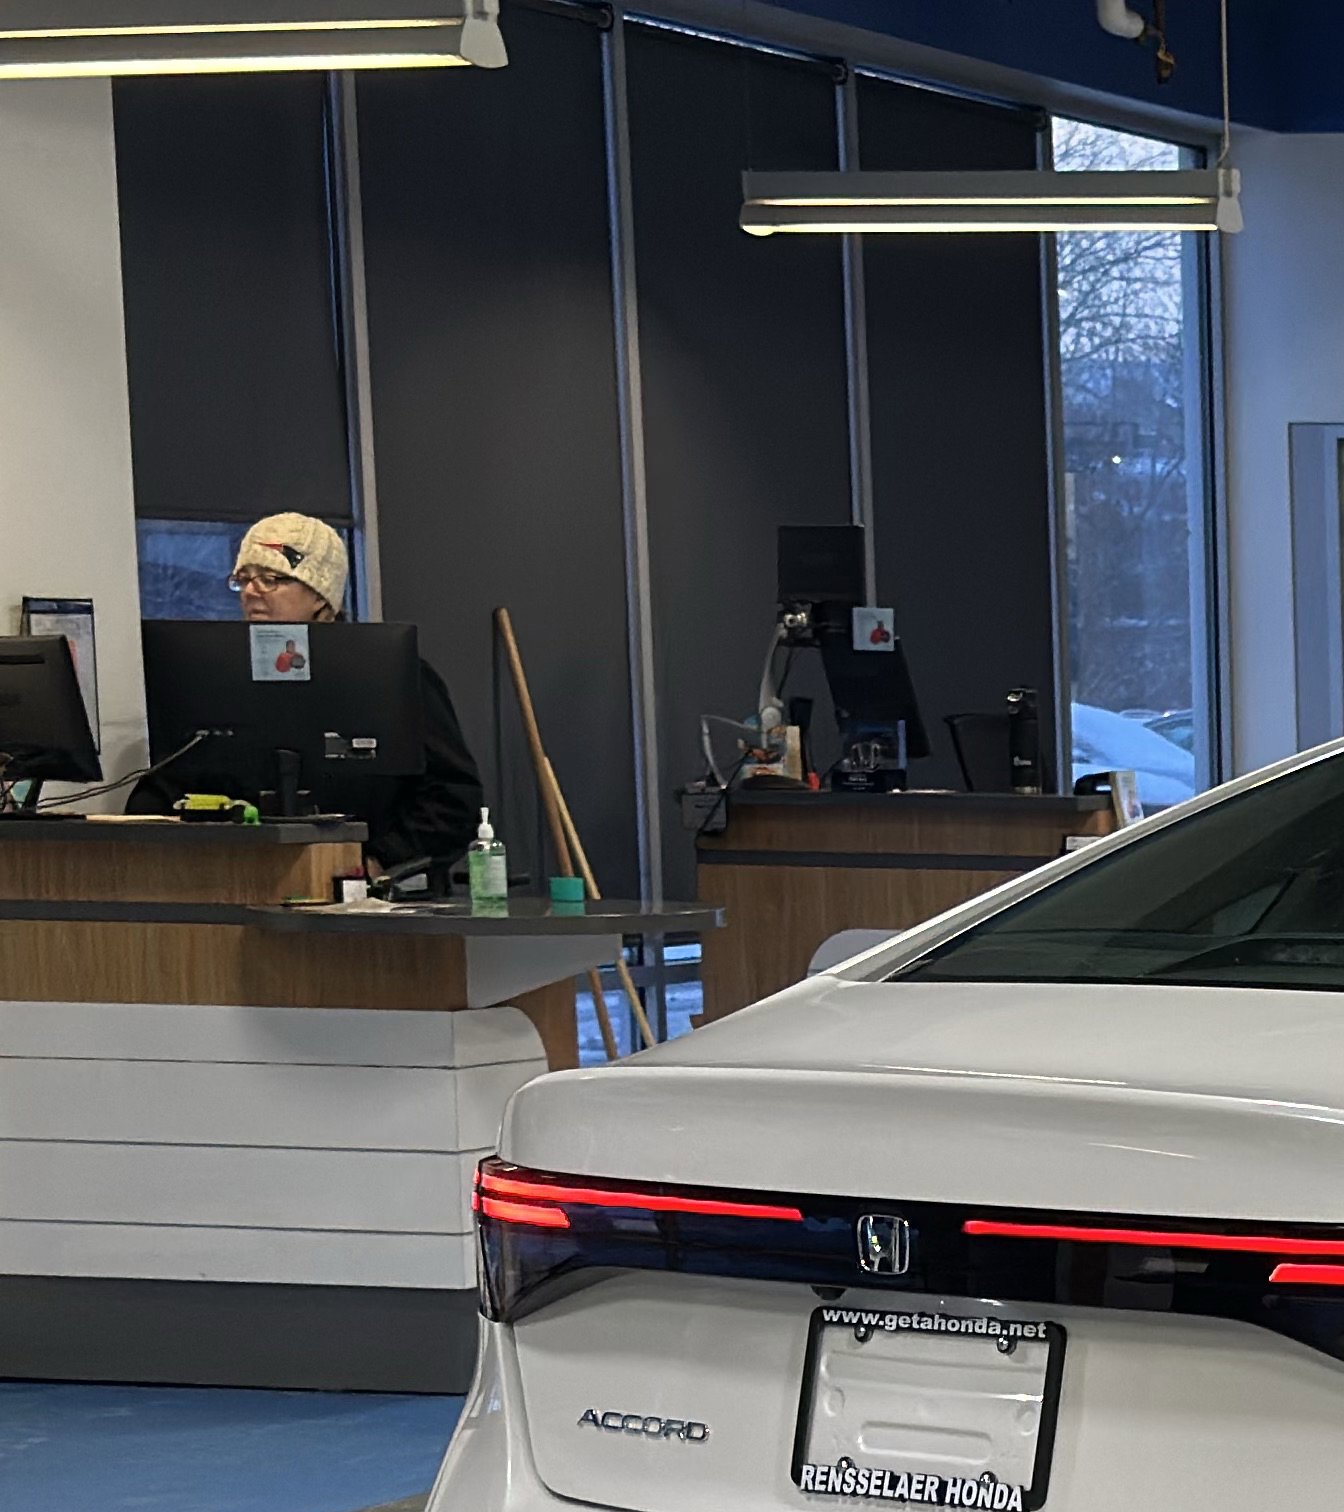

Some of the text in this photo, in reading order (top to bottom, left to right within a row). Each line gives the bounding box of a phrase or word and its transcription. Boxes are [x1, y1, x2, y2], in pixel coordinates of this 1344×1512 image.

[822, 1308, 1047, 1339] www.getahonda.net
[577, 1408, 711, 1442] ACCORD
[800, 1465, 1024, 1512] RENSSELAER HONDA
